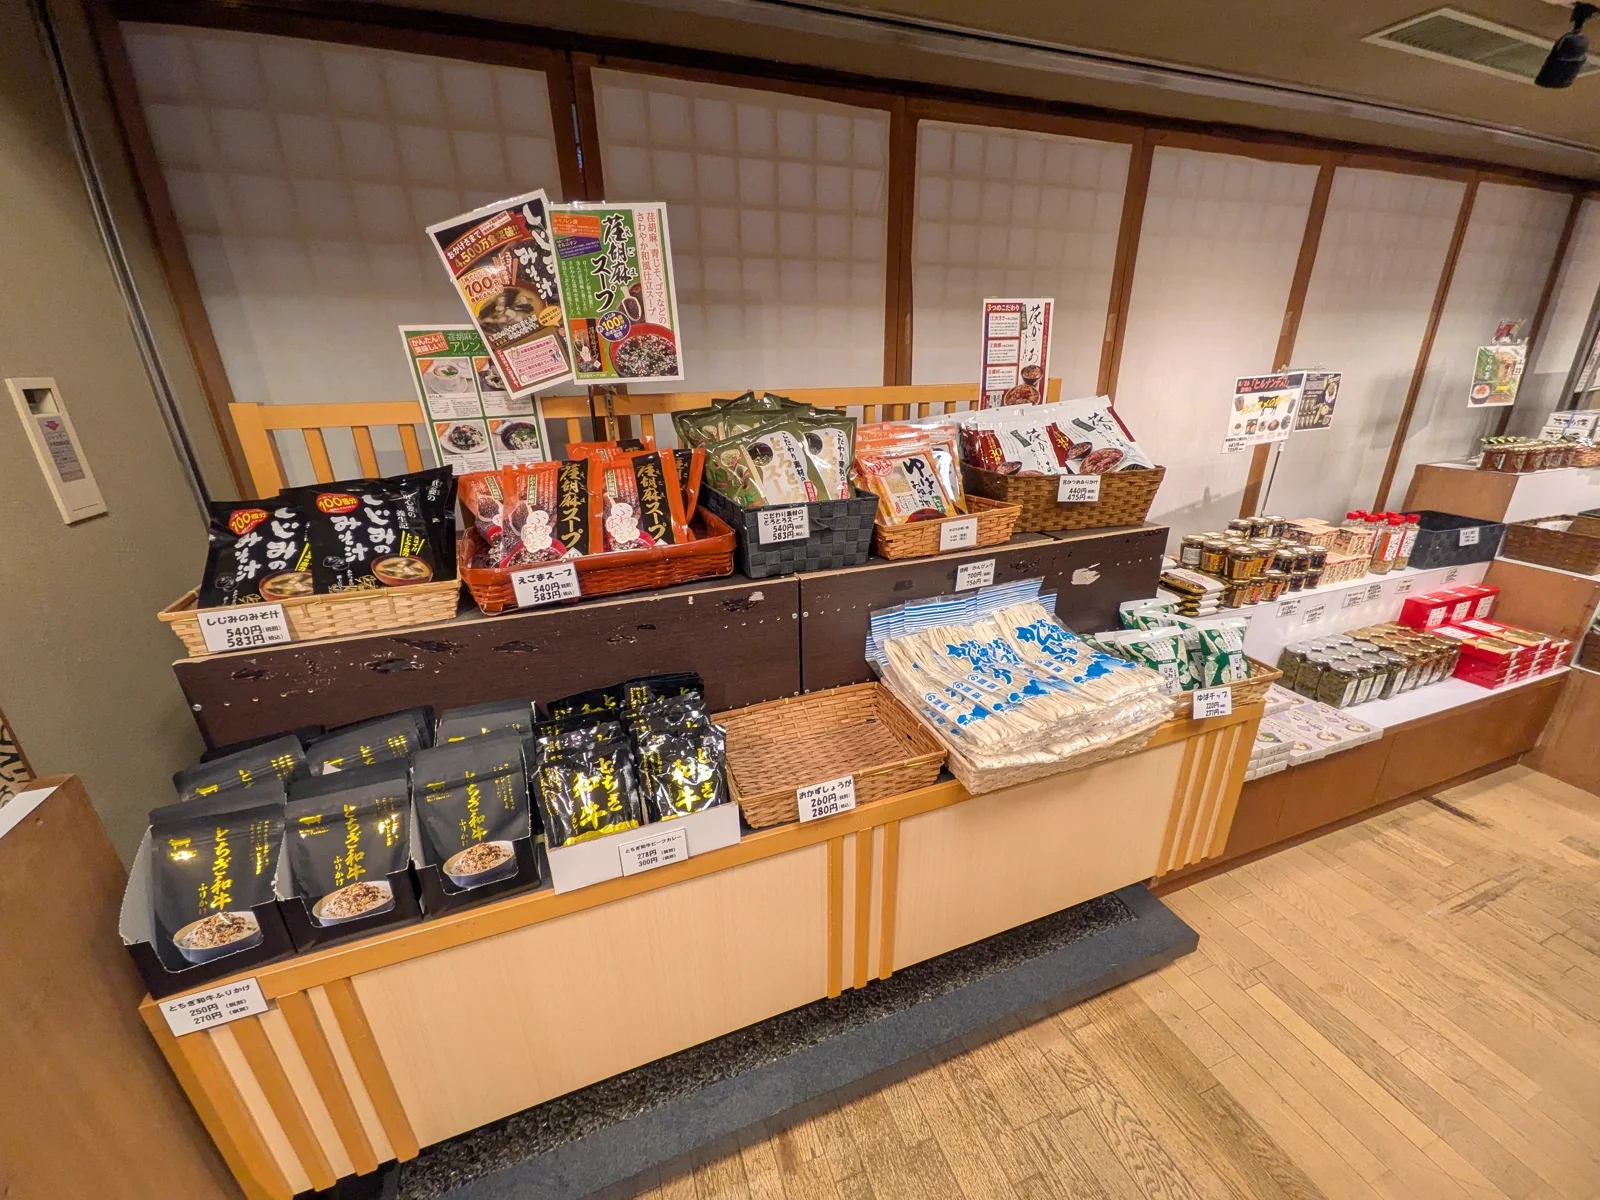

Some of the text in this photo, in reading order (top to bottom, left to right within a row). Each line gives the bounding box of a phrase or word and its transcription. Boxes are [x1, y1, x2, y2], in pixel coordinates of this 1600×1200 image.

[447, 230, 482, 260] おかげさまで
[636, 212, 657, 316] さわやか和風仕立スープ
[646, 212, 667, 324] 荏胡麻、青じそ、ゴマなどの
[514, 247, 553, 300] みそ汁
[591, 256, 616, 312] スープ
[986, 304, 1020, 312] 3つのこだわり
[411, 334, 444, 346] かんたん!!
[781, 431, 807, 482] こだわり素材の
[559, 462, 584, 549] 荏胡麻スープ
[637, 463, 667, 541] 荏胡麻スープ
[763, 509, 804, 520] こだわり素材の
[763, 516, 804, 526] とろとろスープ
[361, 494, 396, 554] しじみの
[773, 524, 795, 533] 540円
[266, 507, 300, 570] しじみの
[330, 515, 369, 562] みそ汁
[772, 531, 794, 541] 583円
[234, 531, 263, 582] みそ汁
[967, 571, 982, 579] 700円
[972, 563, 994, 571] かんぴょう
[518, 568, 573, 585] えごまスープ
[966, 579, 981, 587] 756円
[533, 582, 560, 594] 540円
[534, 590, 561, 602] 583円
[206, 610, 280, 626] しじみのみそ汁
[226, 624, 282, 638] 540円 (税別)
[227, 634, 266, 648] 583円
[1197, 691, 1228, 701] ゆばチップ
[1205, 702, 1219, 710] 220円
[1205, 709, 1220, 717] 237円
[599, 757, 623, 812] とちぎ
[798, 779, 852, 800] おかずしょうが
[464, 770, 488, 841] とちぎ和牛
[572, 771, 607, 829] 和牛
[811, 792, 837, 808] 260円
[812, 802, 838, 818] 280円
[459, 818, 469, 847] ふりかけ
[343, 803, 367, 881] とちぎ和牛
[625, 836, 682, 854] とちぎ和牛ビーフカレー
[637, 849, 657, 860] 278円
[638, 856, 658, 867] 300円
[210, 826, 233, 910] とちぎ和牛
[333, 855, 344, 887] ふりかけ
[198, 882, 208, 915] ふりかけ
[169, 984, 251, 1012] とちぎ和牛ふりかけ
[189, 1003, 219, 1017] 250円
[193, 1011, 223, 1025] 270円
